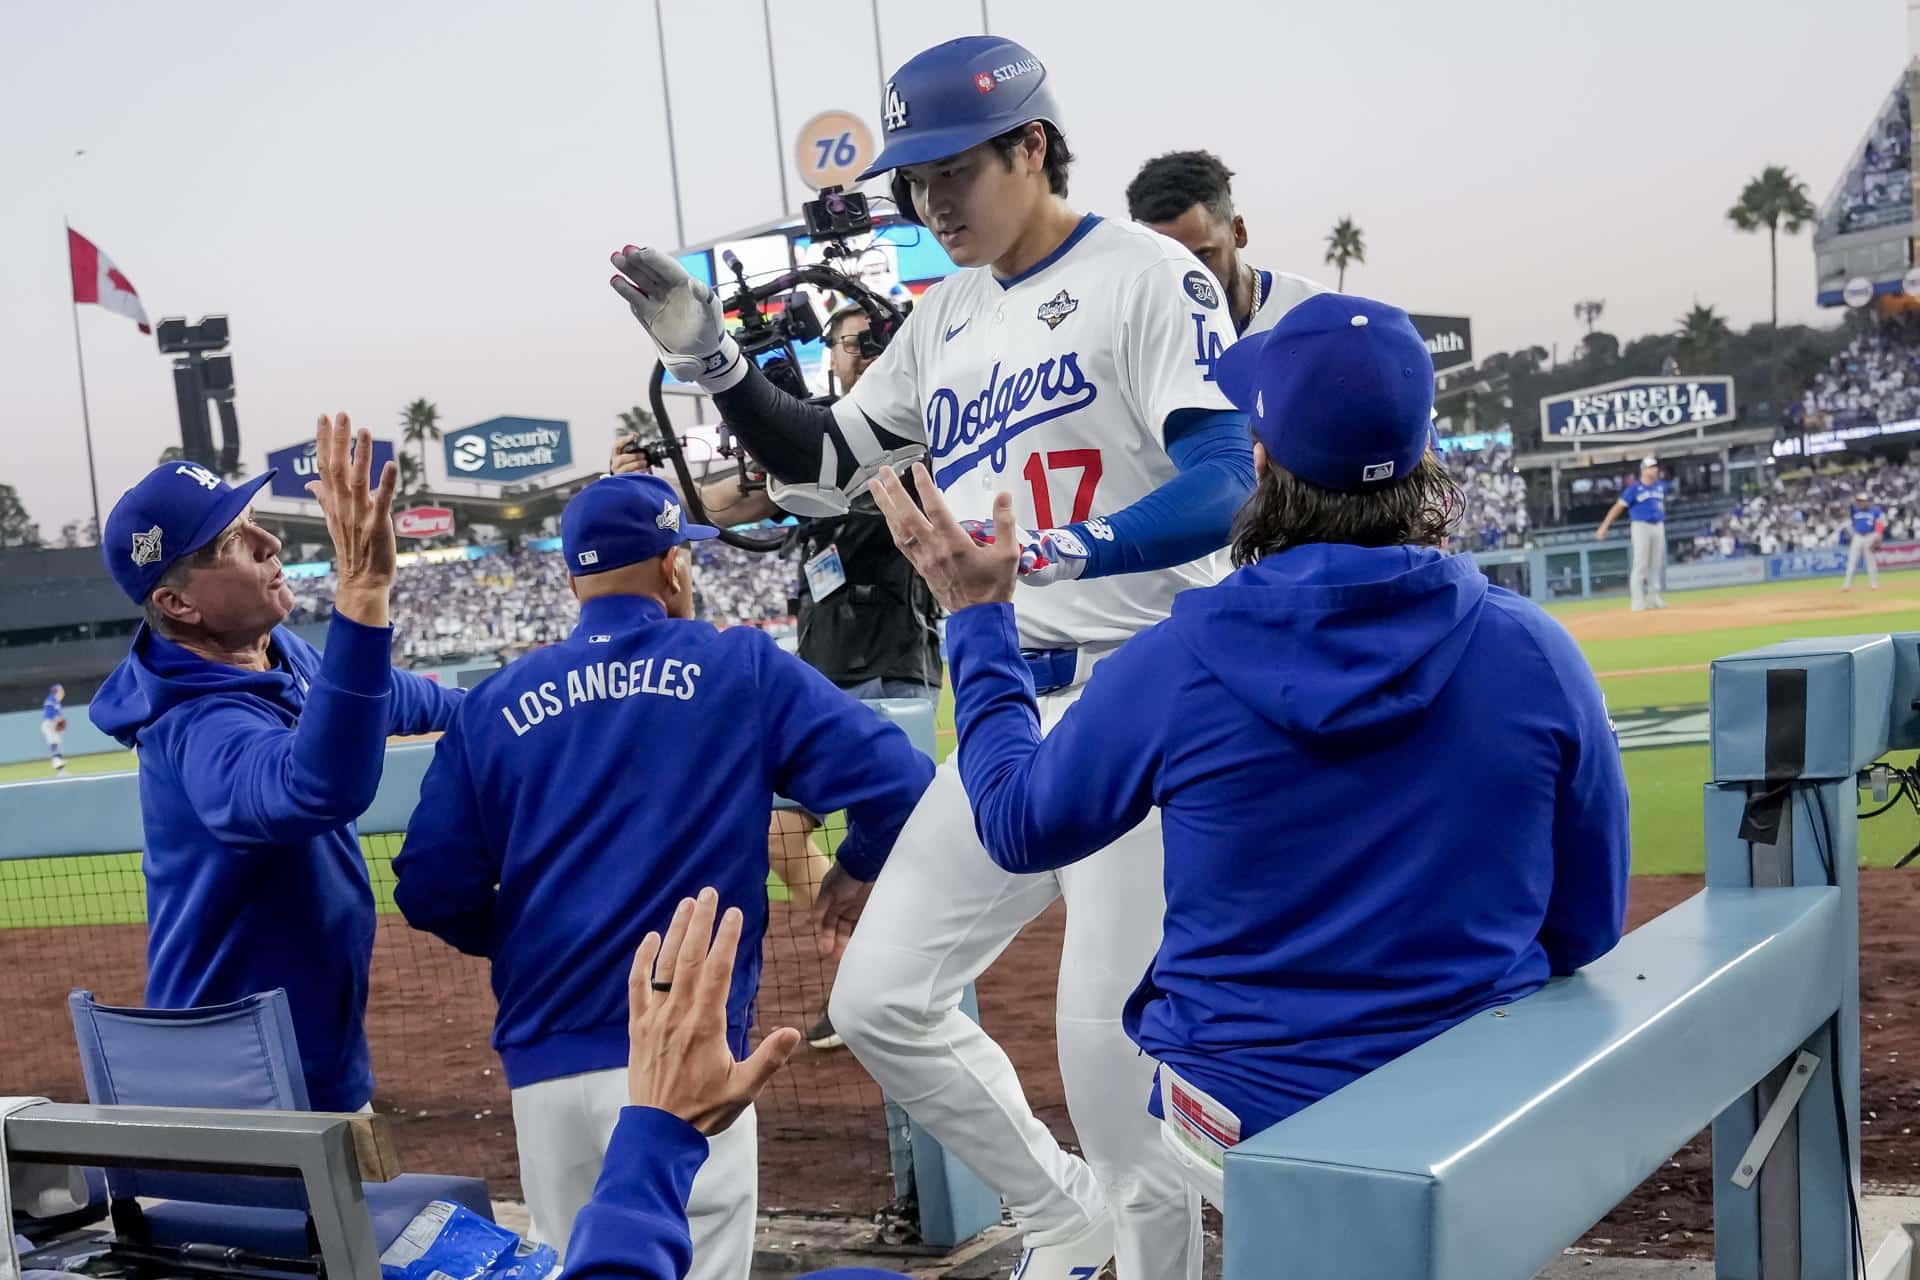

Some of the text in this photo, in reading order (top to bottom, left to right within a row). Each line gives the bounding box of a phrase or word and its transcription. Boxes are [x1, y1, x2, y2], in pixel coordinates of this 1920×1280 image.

[884, 82, 907, 131] LA
[815, 132, 857, 169] 76
[927, 352, 1097, 475] Dodgers
[1560, 406, 1682, 435] JALISCO
[490, 427, 560, 450] Security
[493, 446, 554, 469] Benefit
[1023, 449, 1103, 530] 17
[502, 658, 701, 737] LOS ANGELES
